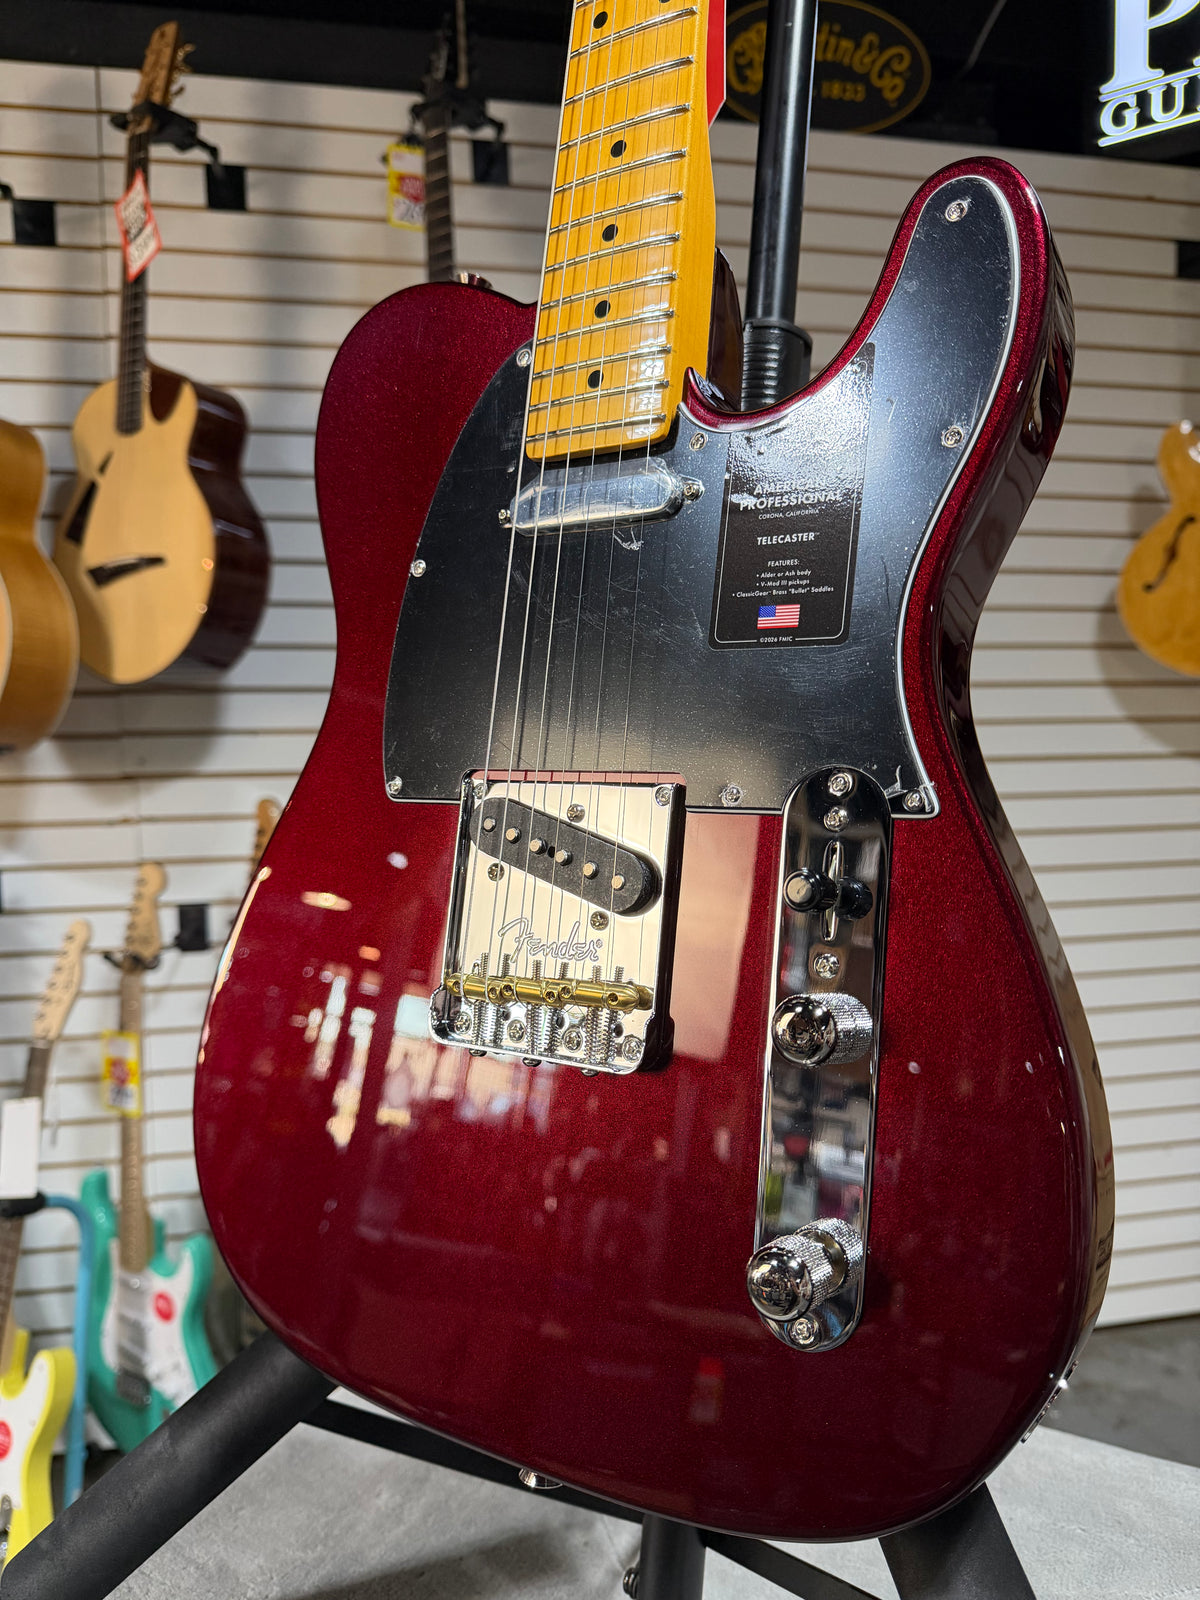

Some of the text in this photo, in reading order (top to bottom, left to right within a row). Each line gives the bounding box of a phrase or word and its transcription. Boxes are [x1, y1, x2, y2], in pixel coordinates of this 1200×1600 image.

[1099, 0, 1200, 95] P
[1100, 74, 1200, 136] GU
[753, 478, 827, 496] AMERICAN
[739, 490, 843, 511] PROFESSIONAL
[758, 509, 820, 520] CORONA, CALIFORNIA
[767, 559, 800, 568] FEATURES:
[796, 569, 812, 577] body
[788, 578, 810, 588] pickups
[772, 588, 787, 596] Brass
[811, 585, 834, 593] Saddles
